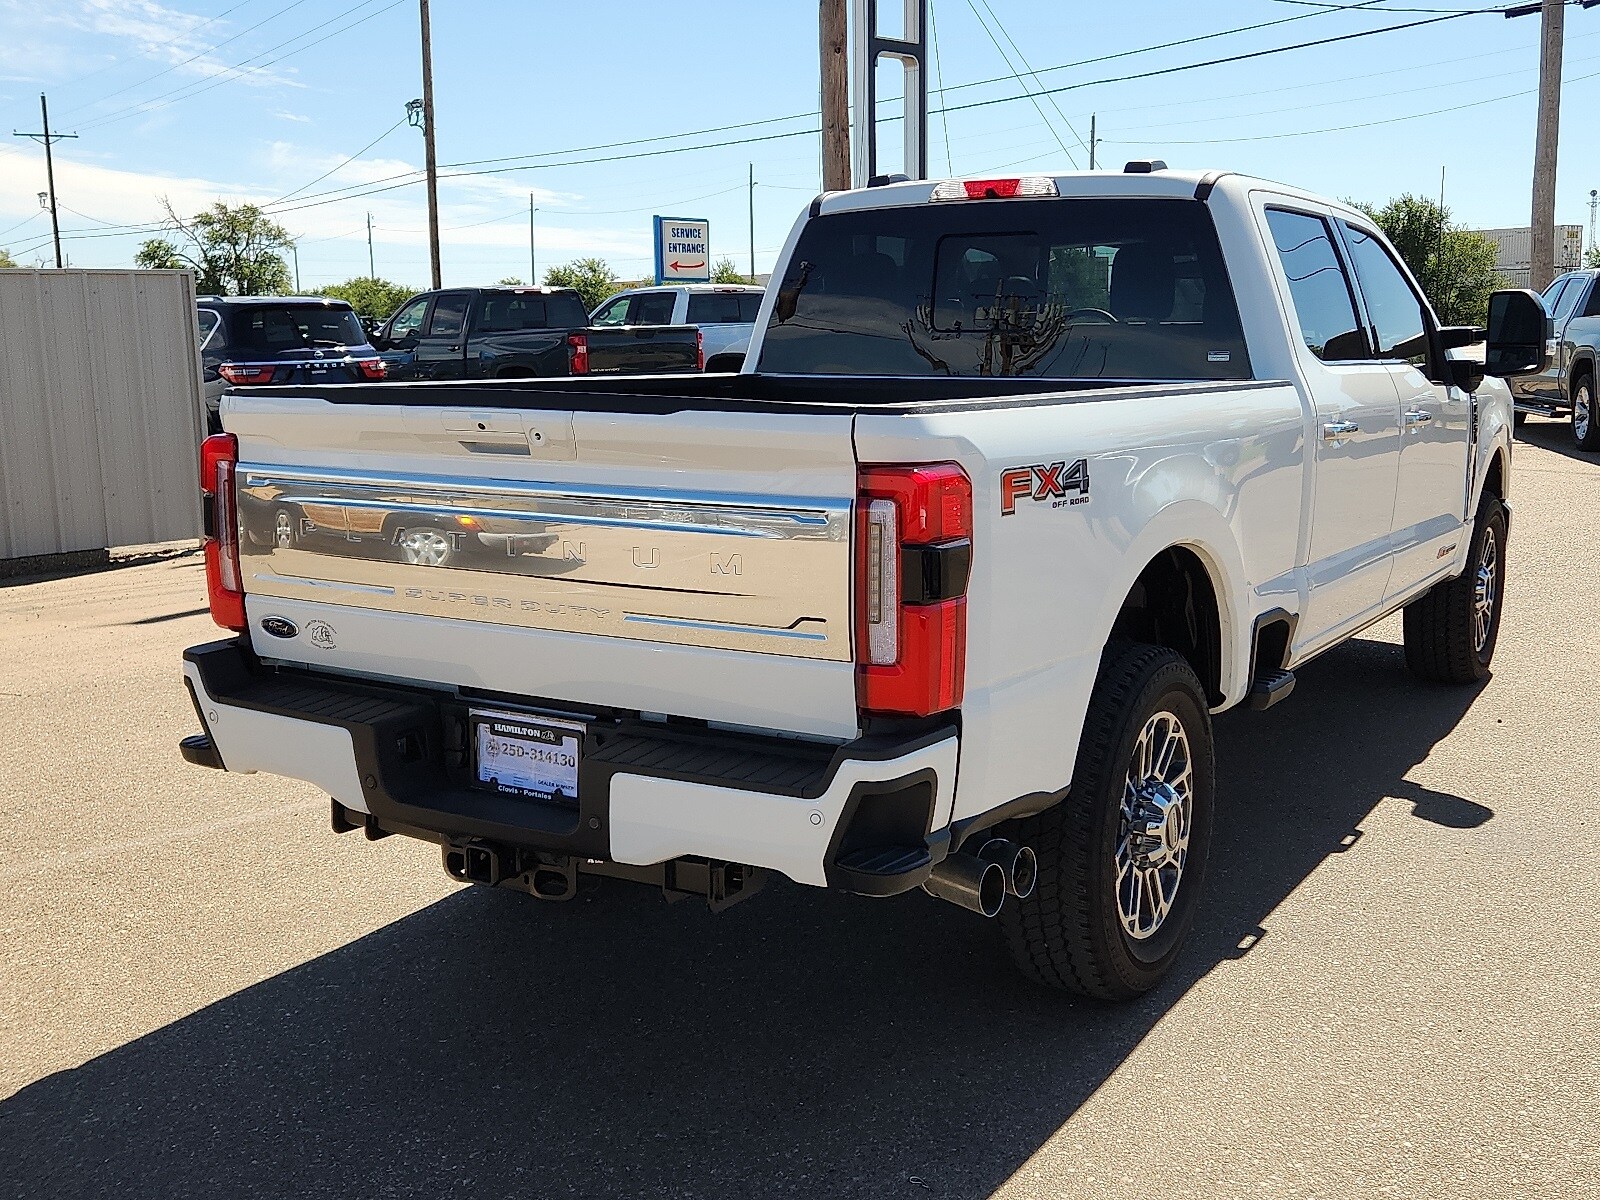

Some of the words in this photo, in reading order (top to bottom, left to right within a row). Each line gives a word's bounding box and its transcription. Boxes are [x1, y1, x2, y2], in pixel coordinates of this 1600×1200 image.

[671, 228, 701, 239] SERVICE
[668, 242, 705, 253] ENTRANCE
[1000, 458, 1090, 517] FX4
[1052, 500, 1067, 509] OFF
[1069, 496, 1090, 506] ROAD
[405, 587, 512, 609] SUPER
[520, 600, 610, 618] DUTY
[493, 723, 541, 738] HAMILTON
[497, 785, 519, 794] Clovis
[523, 789, 552, 800] Portales
